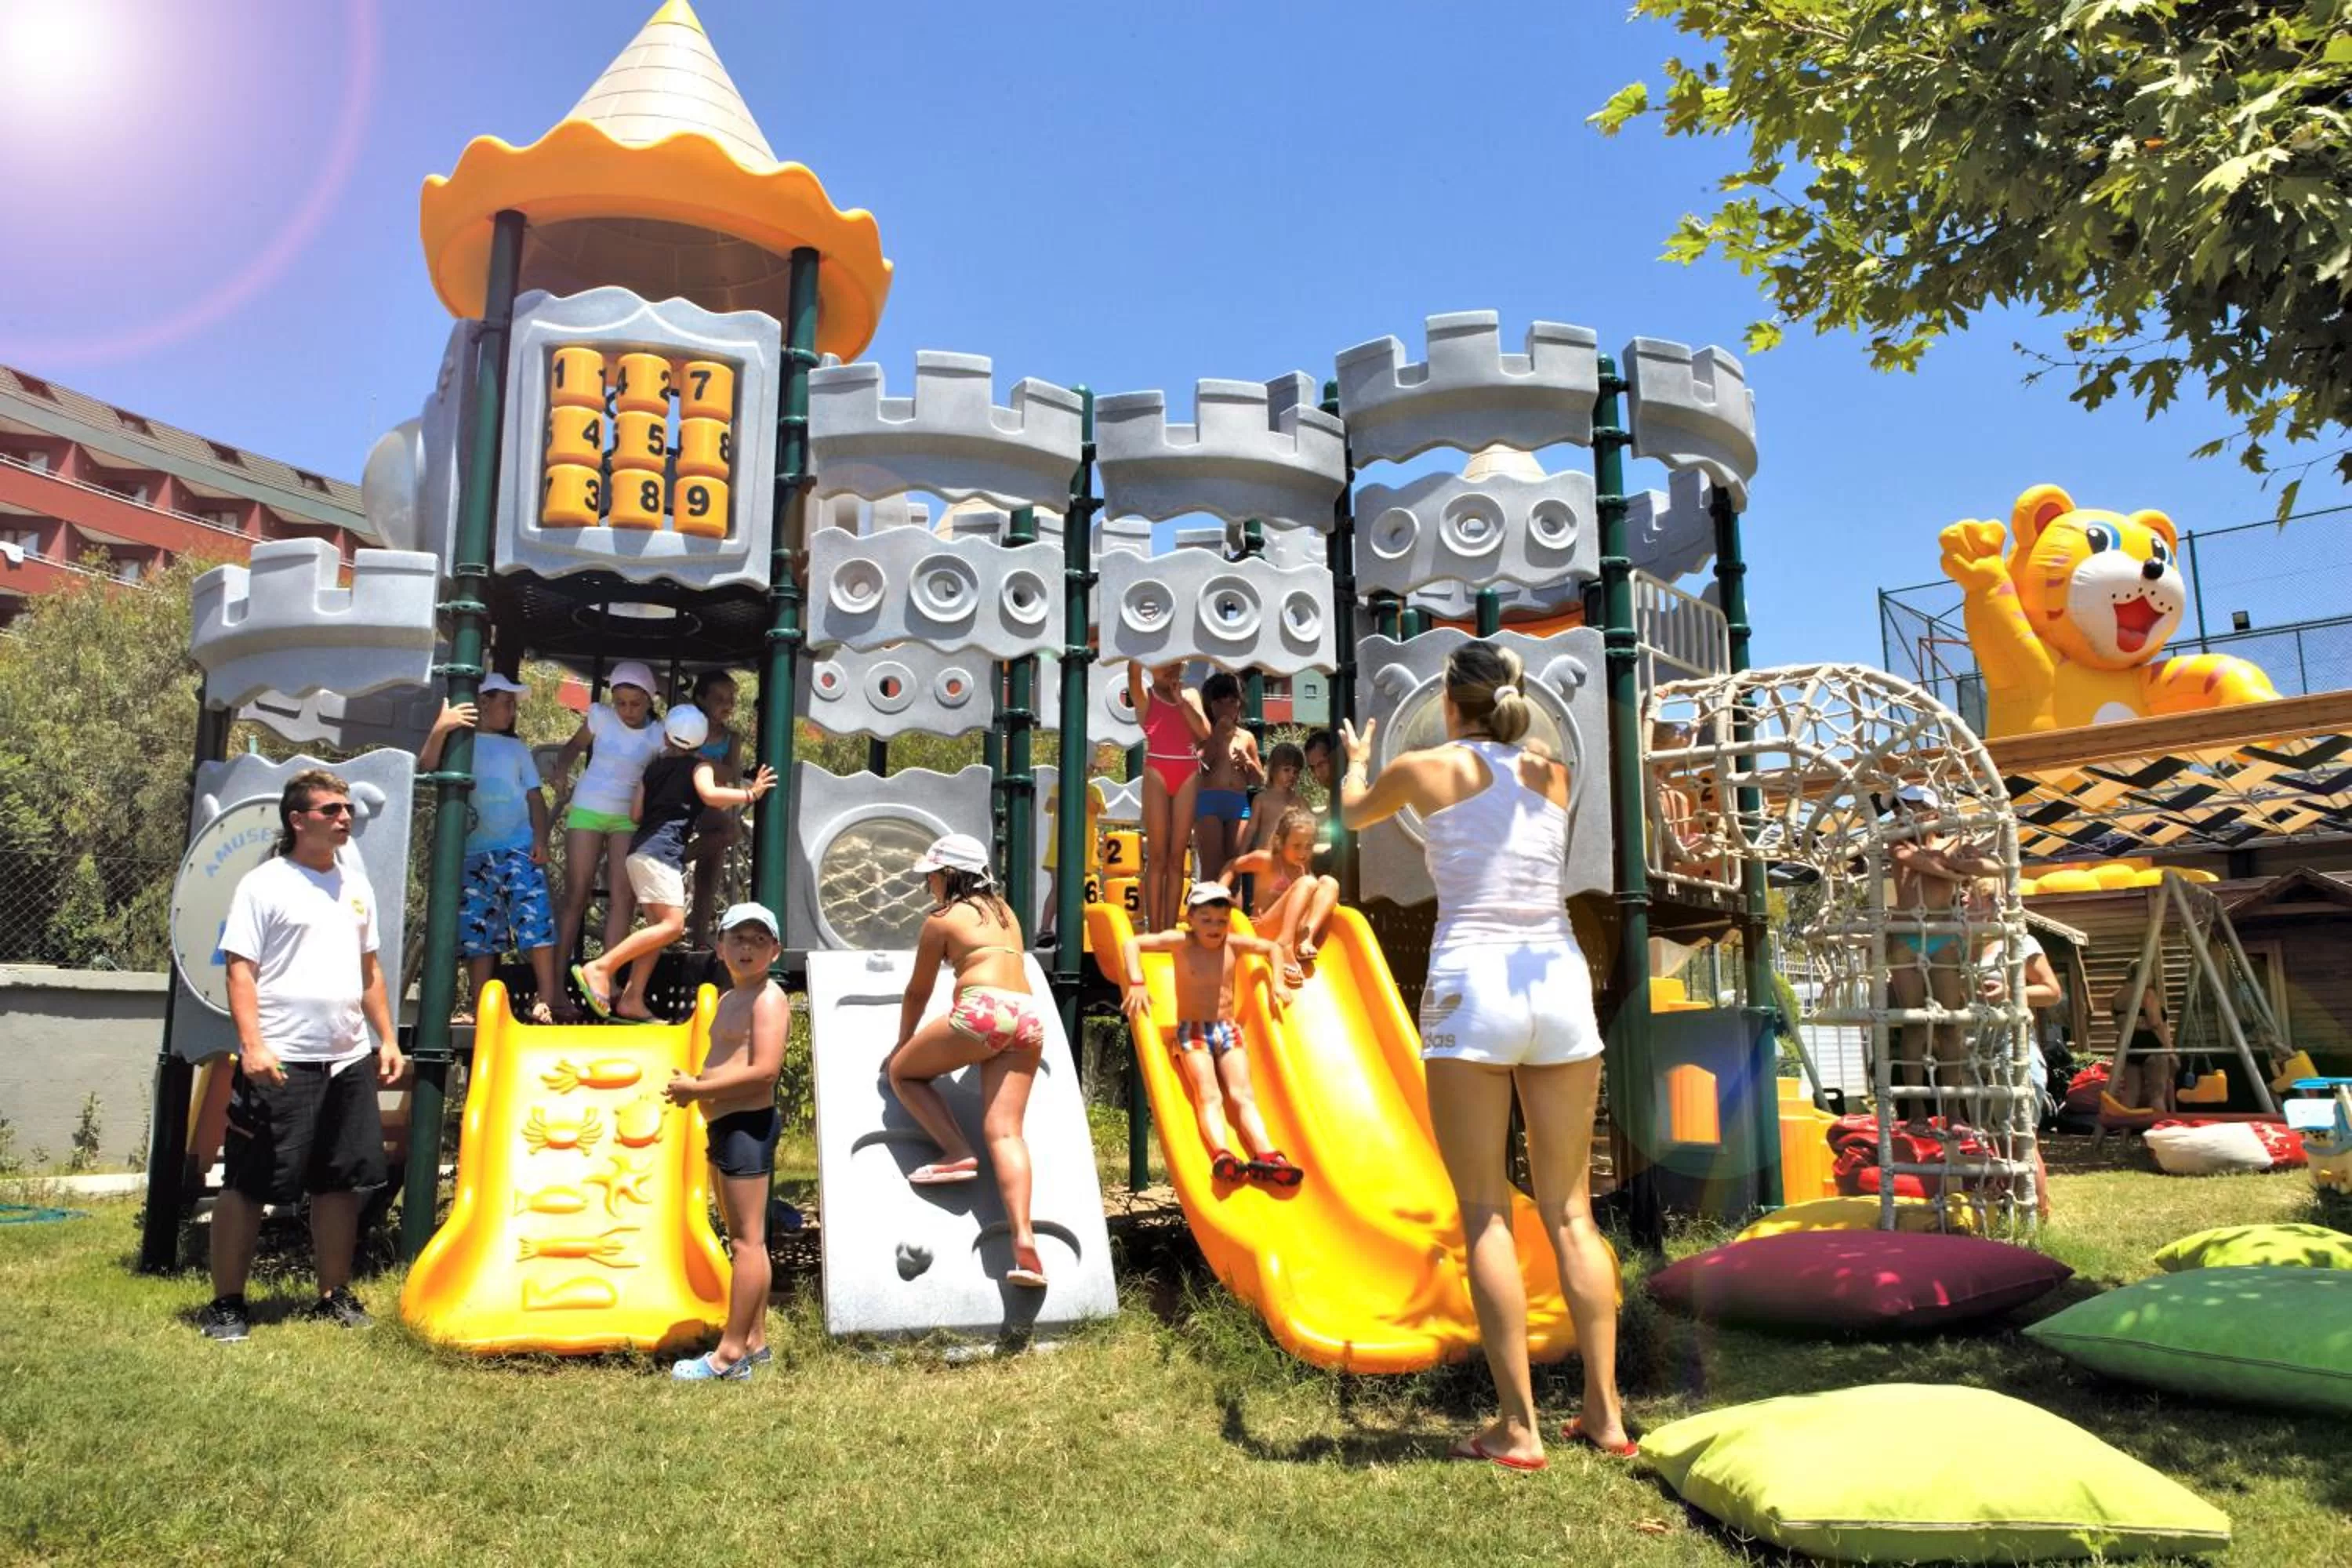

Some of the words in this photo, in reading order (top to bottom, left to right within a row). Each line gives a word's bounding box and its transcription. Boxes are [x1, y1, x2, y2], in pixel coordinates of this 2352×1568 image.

[554, 358, 565, 388] 1
[659, 370, 671, 404] 2
[690, 370, 711, 401] 7
[582, 419, 601, 450] 4
[648, 423, 664, 456] 5
[720, 432, 730, 464] 8
[584, 479, 600, 512] 3
[641, 480, 660, 513] 8
[687, 486, 710, 516] 9
[205, 827, 271, 877] AMUSE
[1106, 839, 1123, 864] 2
[1084, 880, 1098, 903] 6
[1124, 886, 1140, 911] 5
[1424, 1031, 1455, 1048] das
